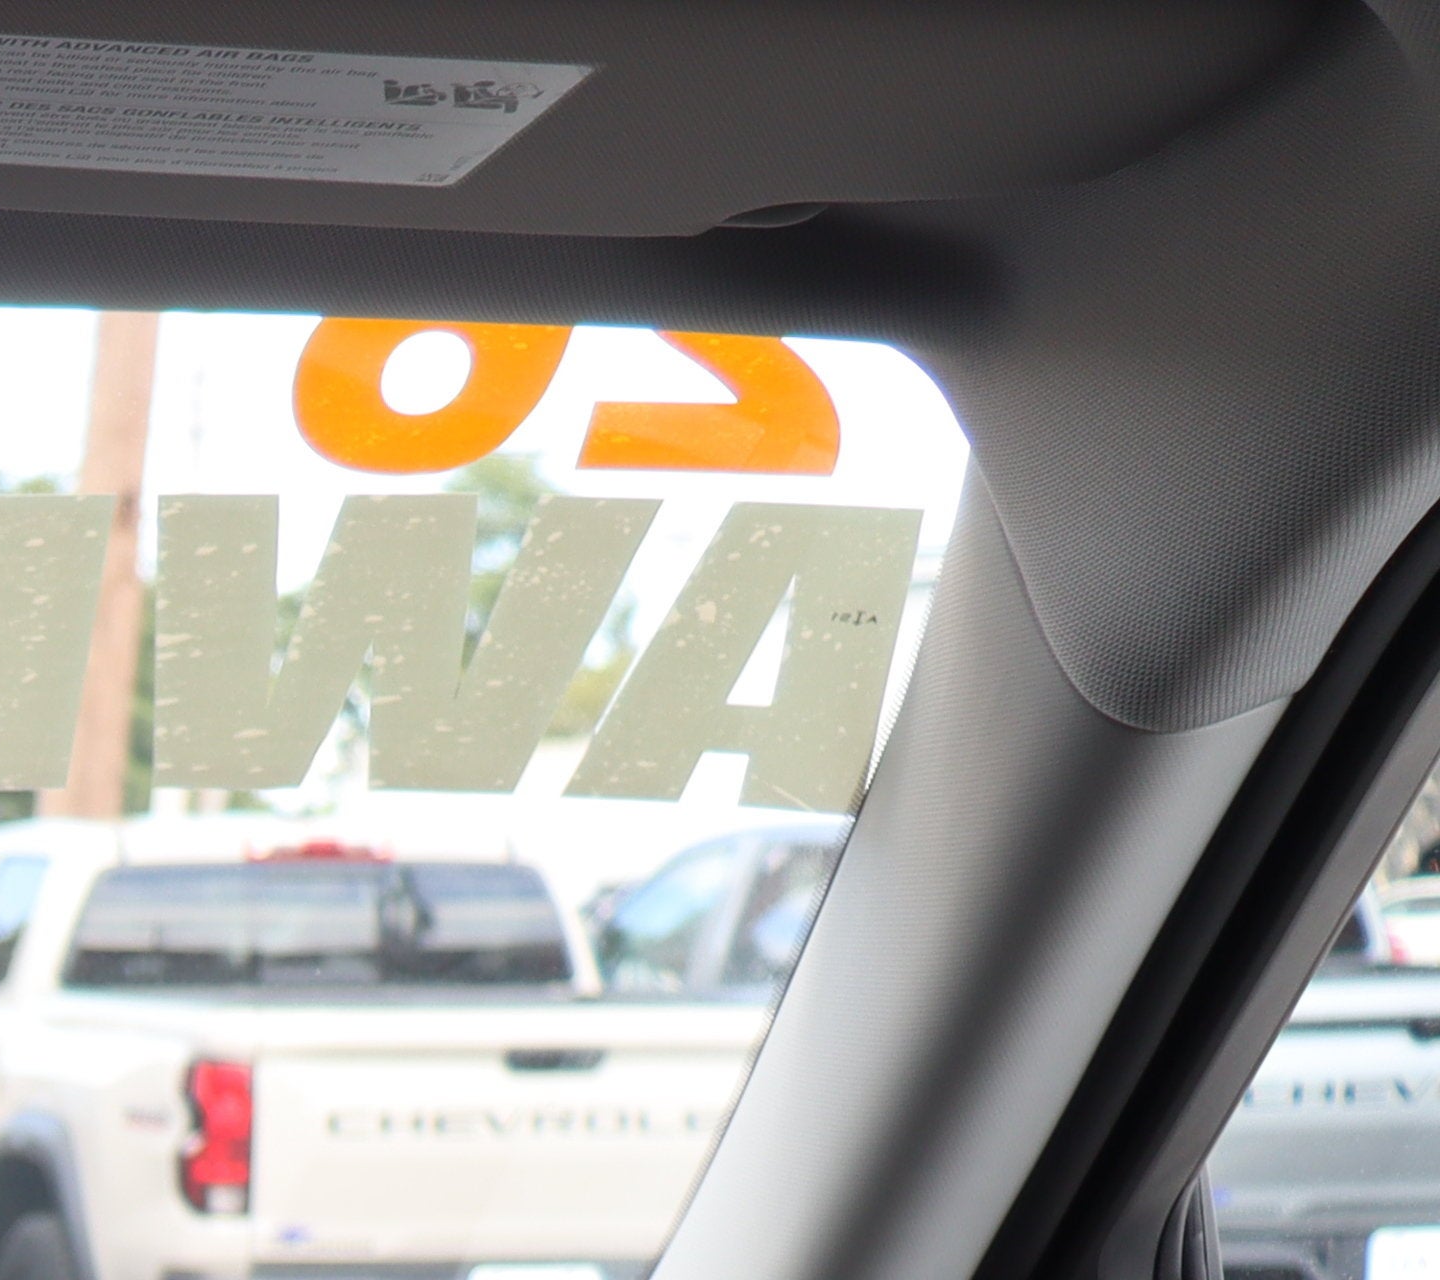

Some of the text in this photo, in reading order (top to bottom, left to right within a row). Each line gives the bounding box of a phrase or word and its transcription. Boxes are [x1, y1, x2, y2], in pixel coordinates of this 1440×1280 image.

[56, 41, 190, 56] ADVANCED
[197, 48, 239, 58] AIR
[246, 52, 315, 63] BAGS
